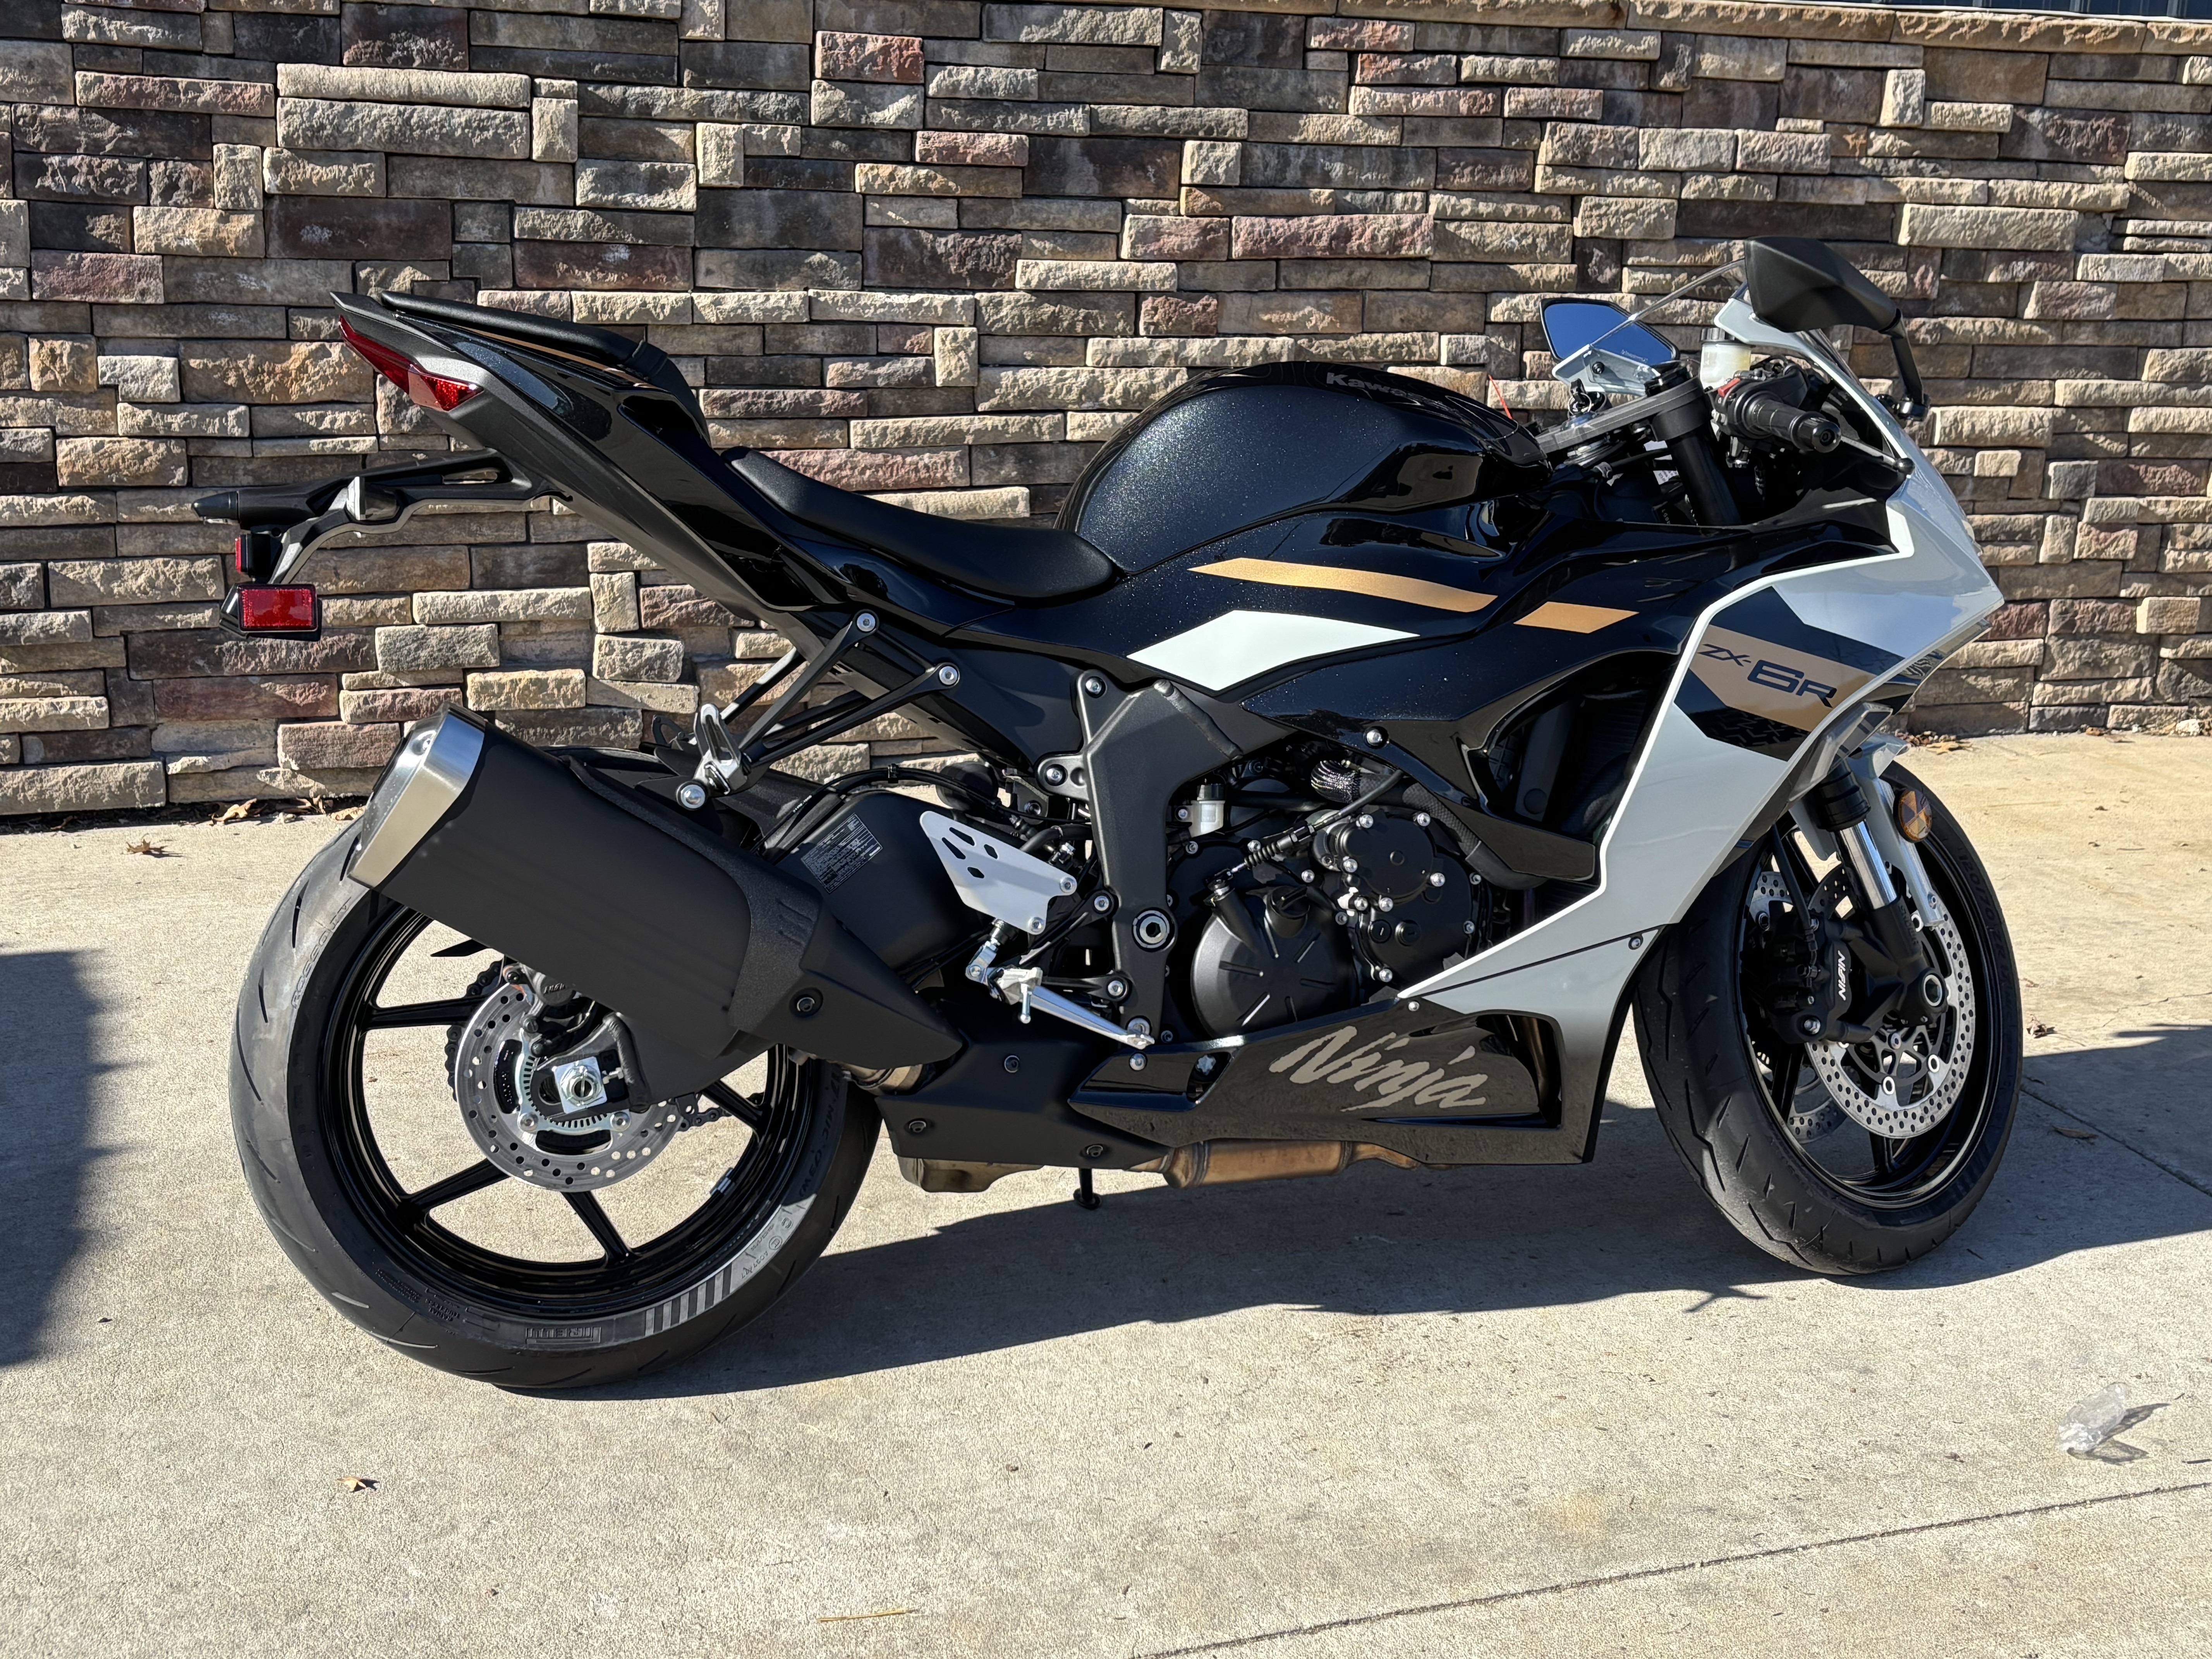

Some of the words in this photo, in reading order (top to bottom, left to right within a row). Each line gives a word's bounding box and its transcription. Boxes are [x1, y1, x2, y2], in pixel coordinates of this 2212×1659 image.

[1838, 950, 1846, 1001] NISSIN
[1269, 1025, 1487, 1112] Ninja
[526, 1326, 602, 1345] PIRELLI
